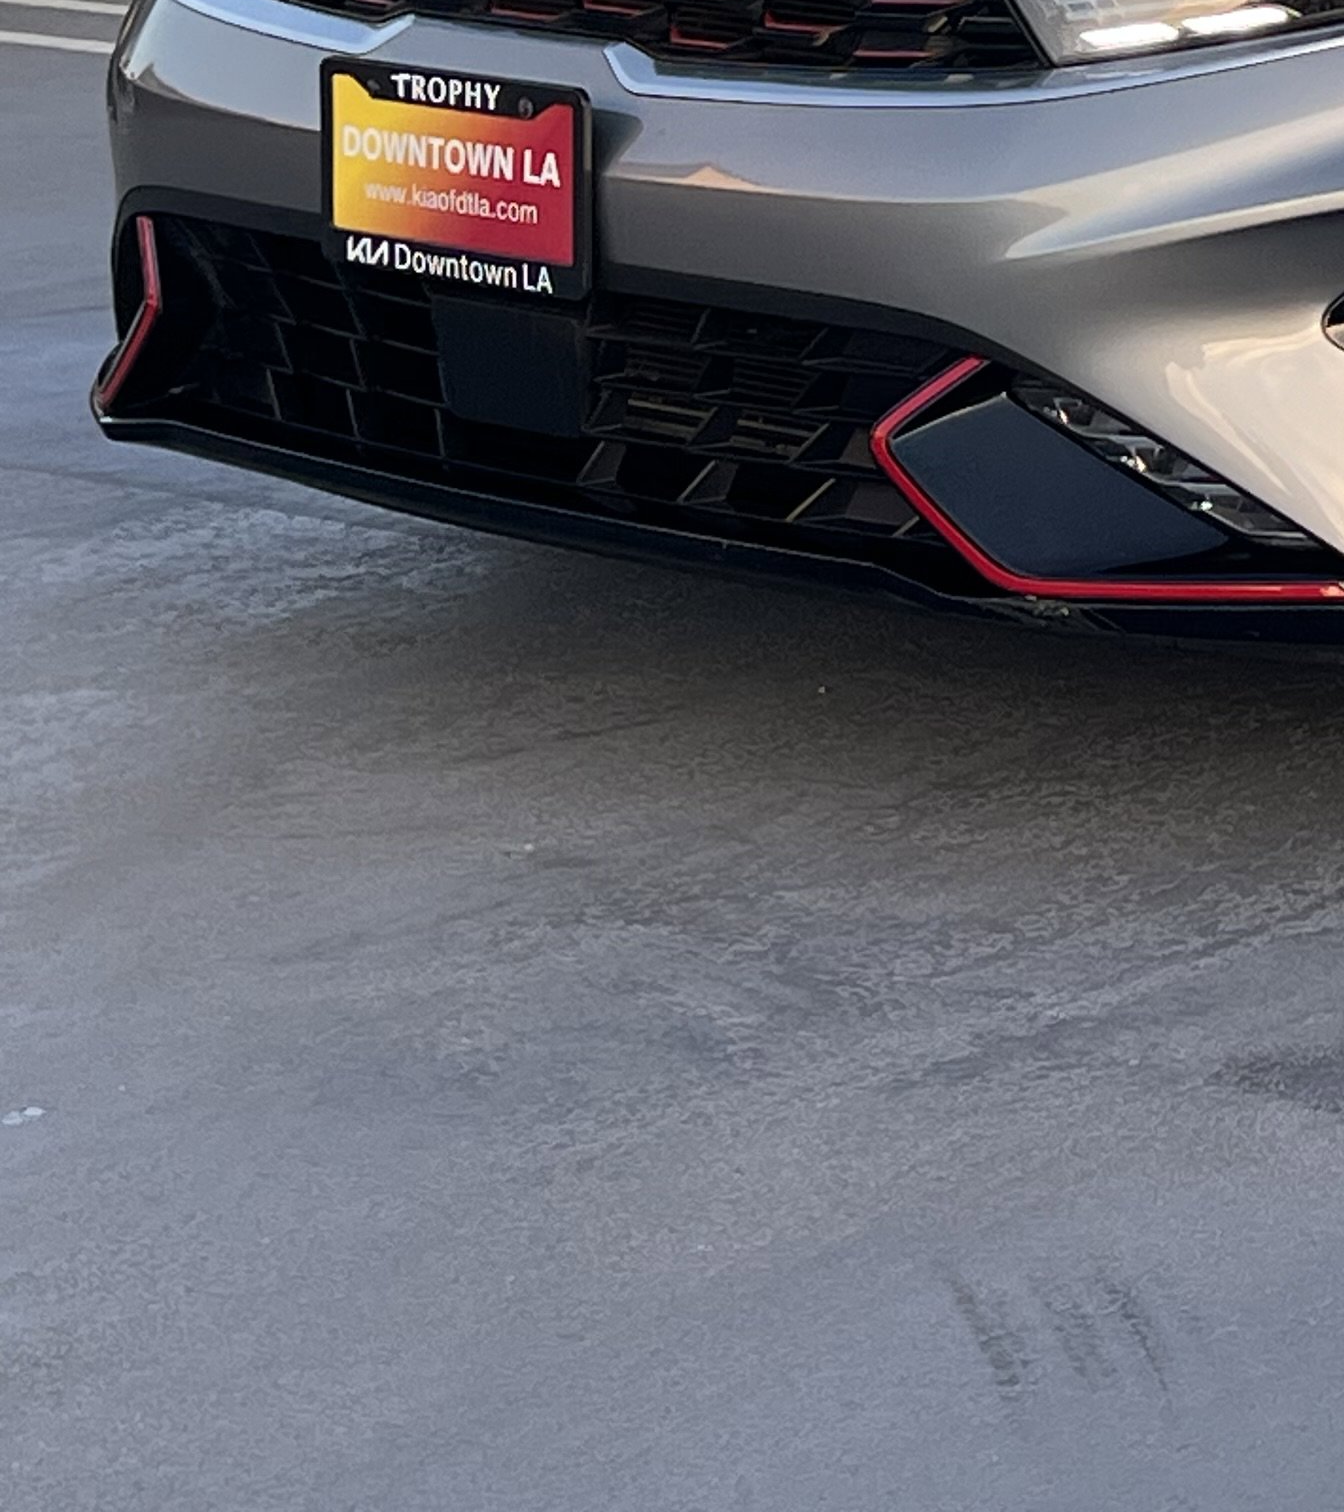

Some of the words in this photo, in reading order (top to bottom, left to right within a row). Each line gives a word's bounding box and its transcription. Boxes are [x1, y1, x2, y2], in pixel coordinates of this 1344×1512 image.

[391, 73, 501, 110] TROPHY
[342, 125, 514, 181] DOWNTOWN
[523, 149, 561, 188] LA
[364, 183, 538, 225] www.kiaofdtla.com
[346, 235, 389, 266] KIA
[395, 244, 517, 289] Downtown
[522, 263, 553, 294] LA
